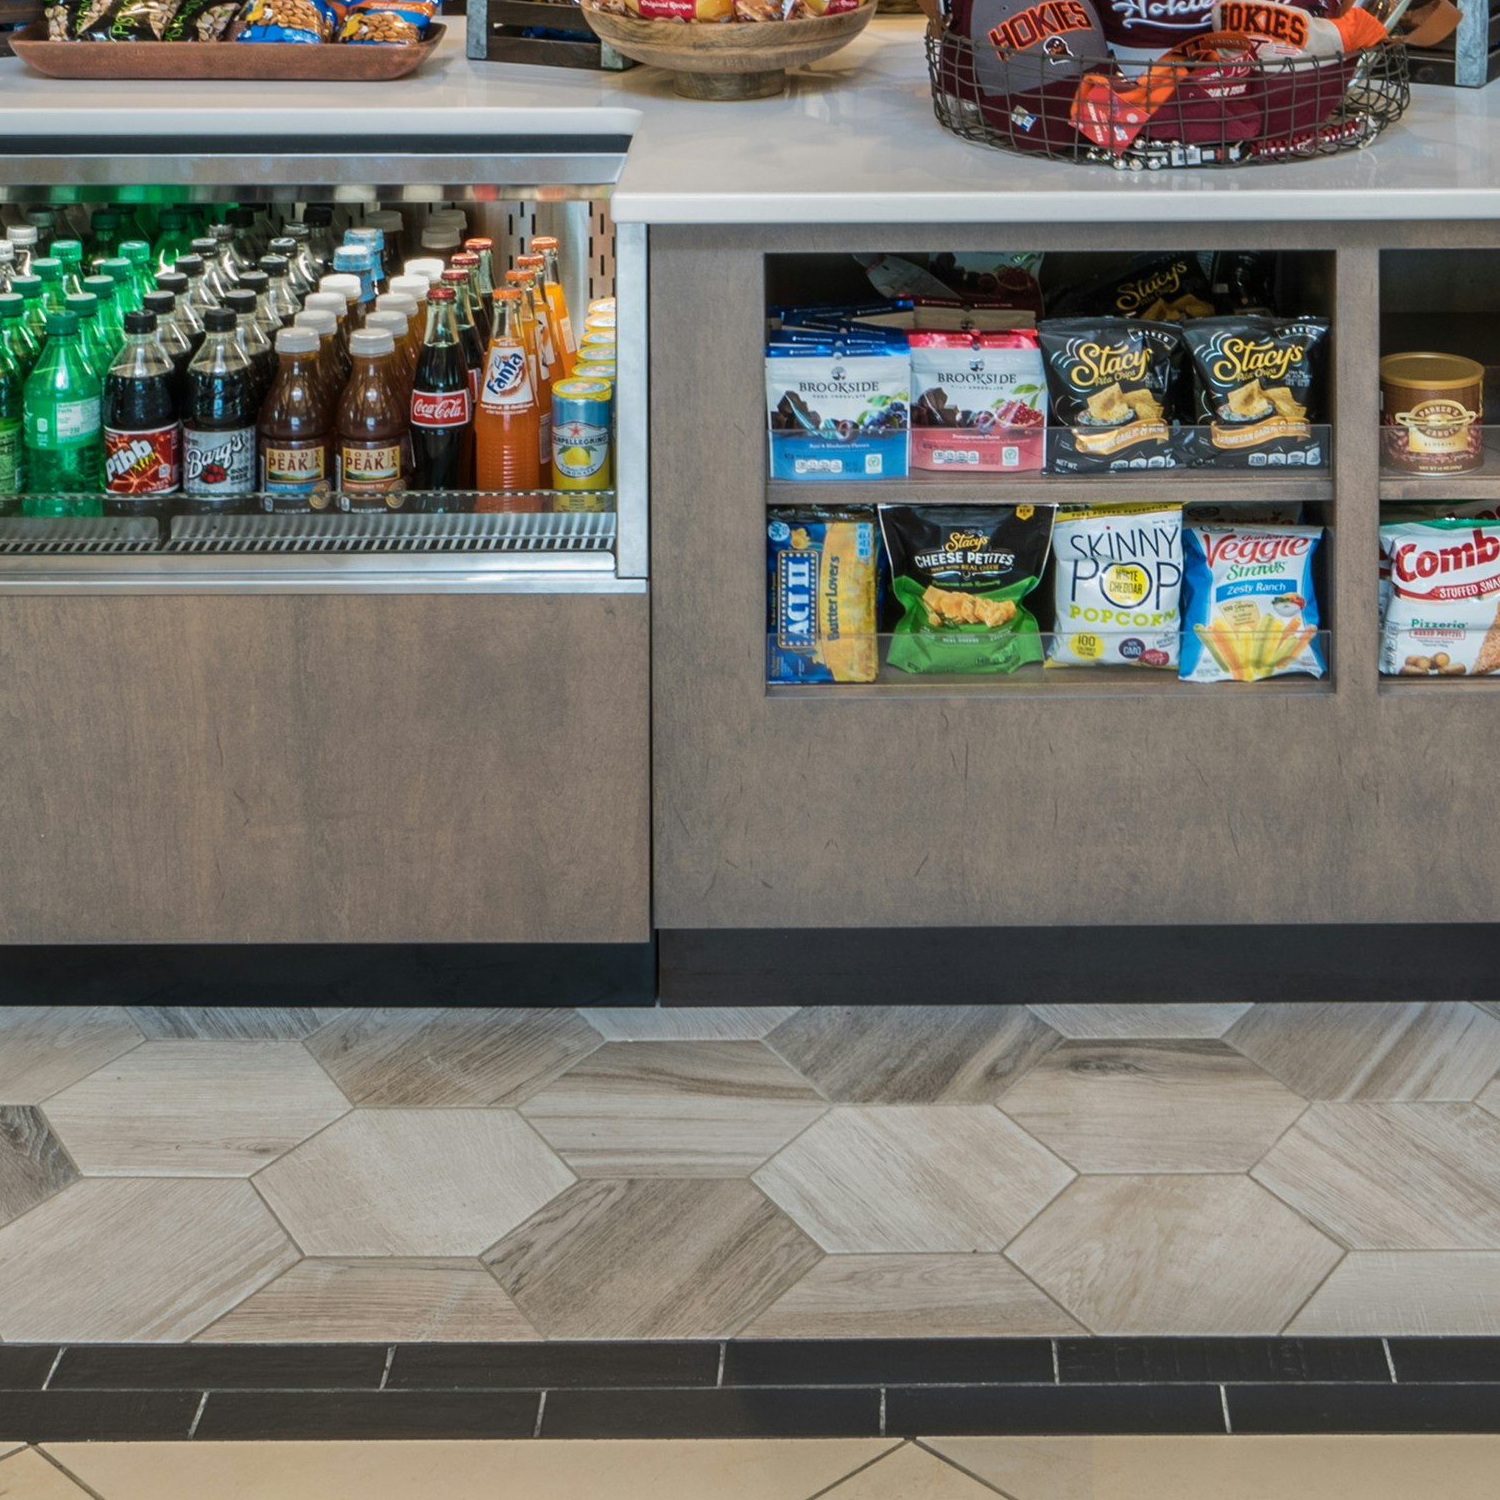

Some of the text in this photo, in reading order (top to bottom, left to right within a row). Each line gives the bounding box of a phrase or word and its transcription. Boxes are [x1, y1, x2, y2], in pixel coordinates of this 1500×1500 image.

[640, 0, 670, 10] Original
[1220, 1, 1308, 47] HOKIES
[1116, 260, 1187, 311] Stacy's
[1213, 337, 1303, 383] Stacy's
[486, 352, 523, 395] Fanta
[937, 372, 1017, 385] BROOKSIDE
[1255, 366, 1277, 379] Chips
[798, 381, 879, 393] BROOKSIDE
[413, 398, 462, 419] Coca-Cola
[1418, 404, 1459, 418] PARKER'S
[105, 439, 153, 482] Pibb
[187, 434, 243, 478] Barq's
[268, 458, 308, 470] PEAK
[345, 458, 385, 470] PEAK
[945, 532, 990, 553] Stacy's
[1203, 533, 1309, 569] Veggie
[914, 551, 962, 569] CHEESE
[1226, 561, 1286, 581] Straws
[1071, 559, 1182, 611] POP
[1109, 580, 1143, 596] CHEDDAR
[1226, 582, 1287, 596] Zesty Ranch
[1439, 583, 1479, 599] STUFFED
[788, 561, 810, 639] ACT II
[826, 556, 841, 641] Butter Lovers
[1070, 604, 1178, 628] POPCORN
[1411, 618, 1466, 629] Pizzeria
[1077, 635, 1096, 646] 100
